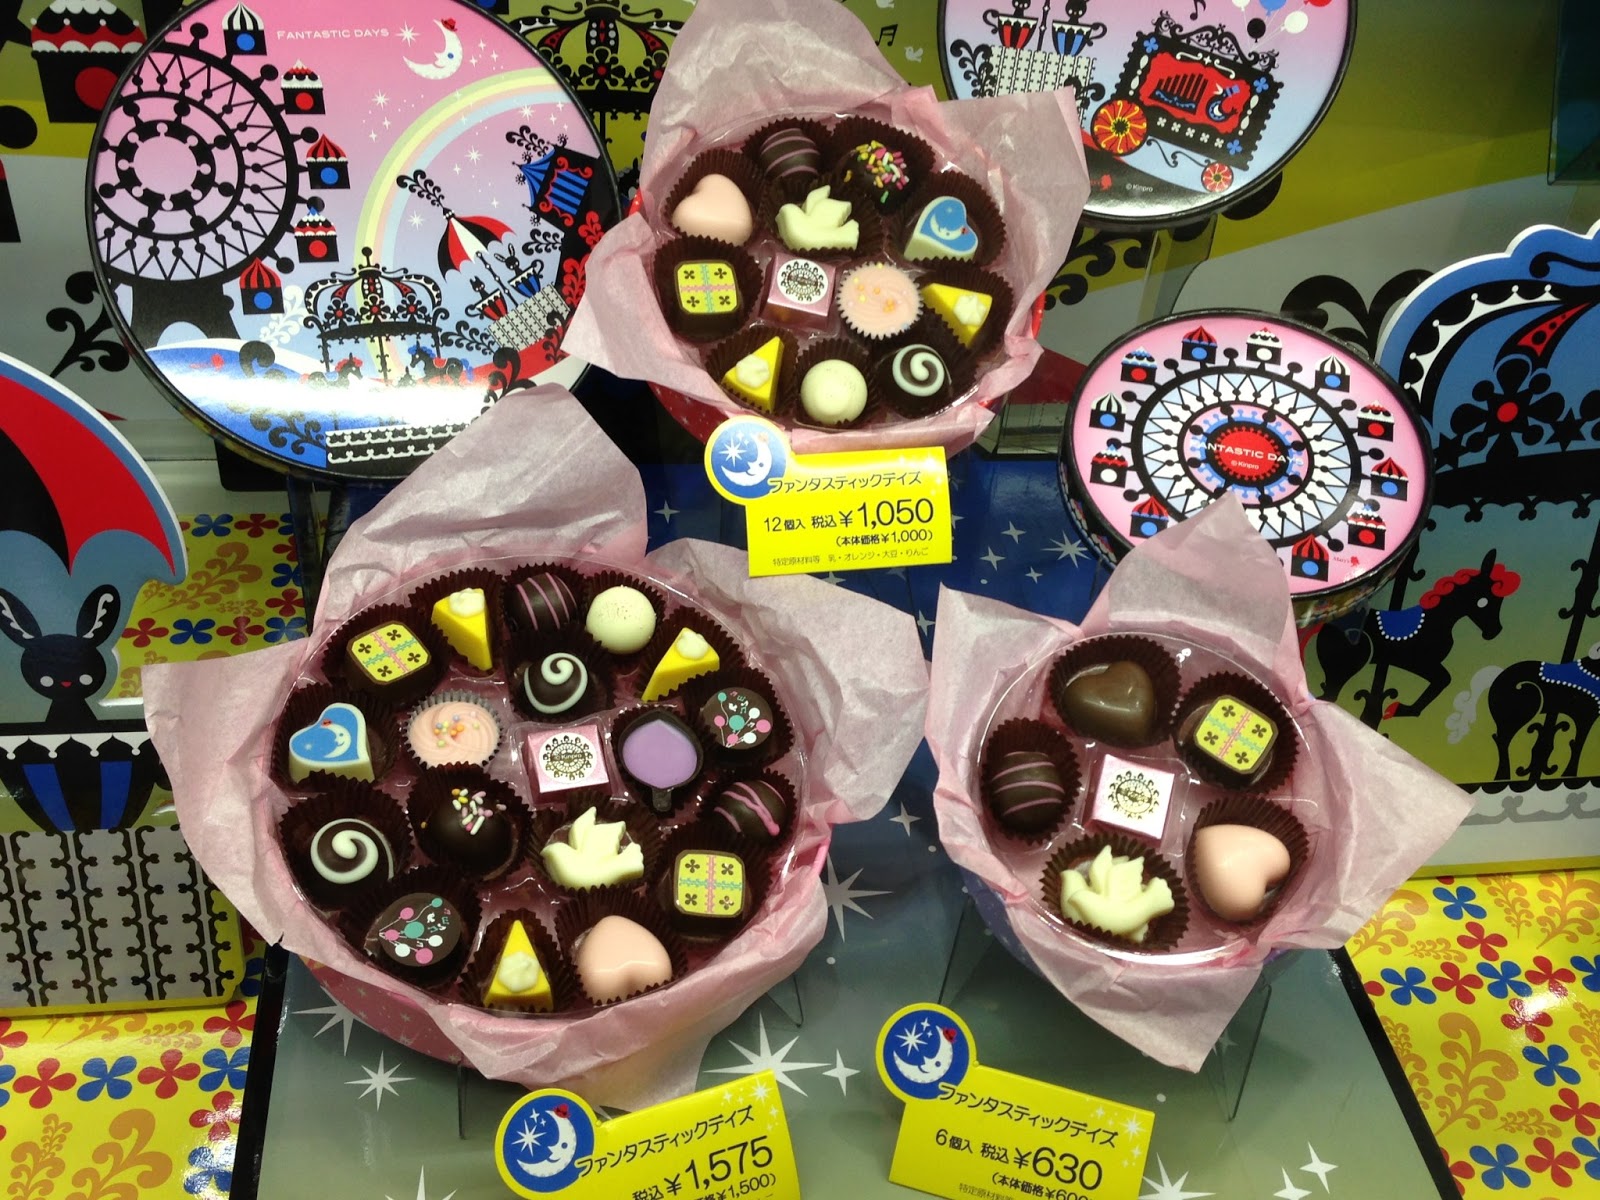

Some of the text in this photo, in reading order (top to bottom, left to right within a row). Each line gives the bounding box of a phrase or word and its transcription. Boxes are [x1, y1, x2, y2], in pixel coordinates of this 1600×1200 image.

[276, 28, 389, 40] FANTASTIC DAYS
[768, 471, 922, 495] ファンタスティックデイズ
[763, 517, 806, 533] 12個入
[941, 1084, 1119, 1149] ファンタスティックデイズ
[577, 1104, 755, 1178] ファンタスティックデイズ
[935, 1128, 974, 1154] 6個入
